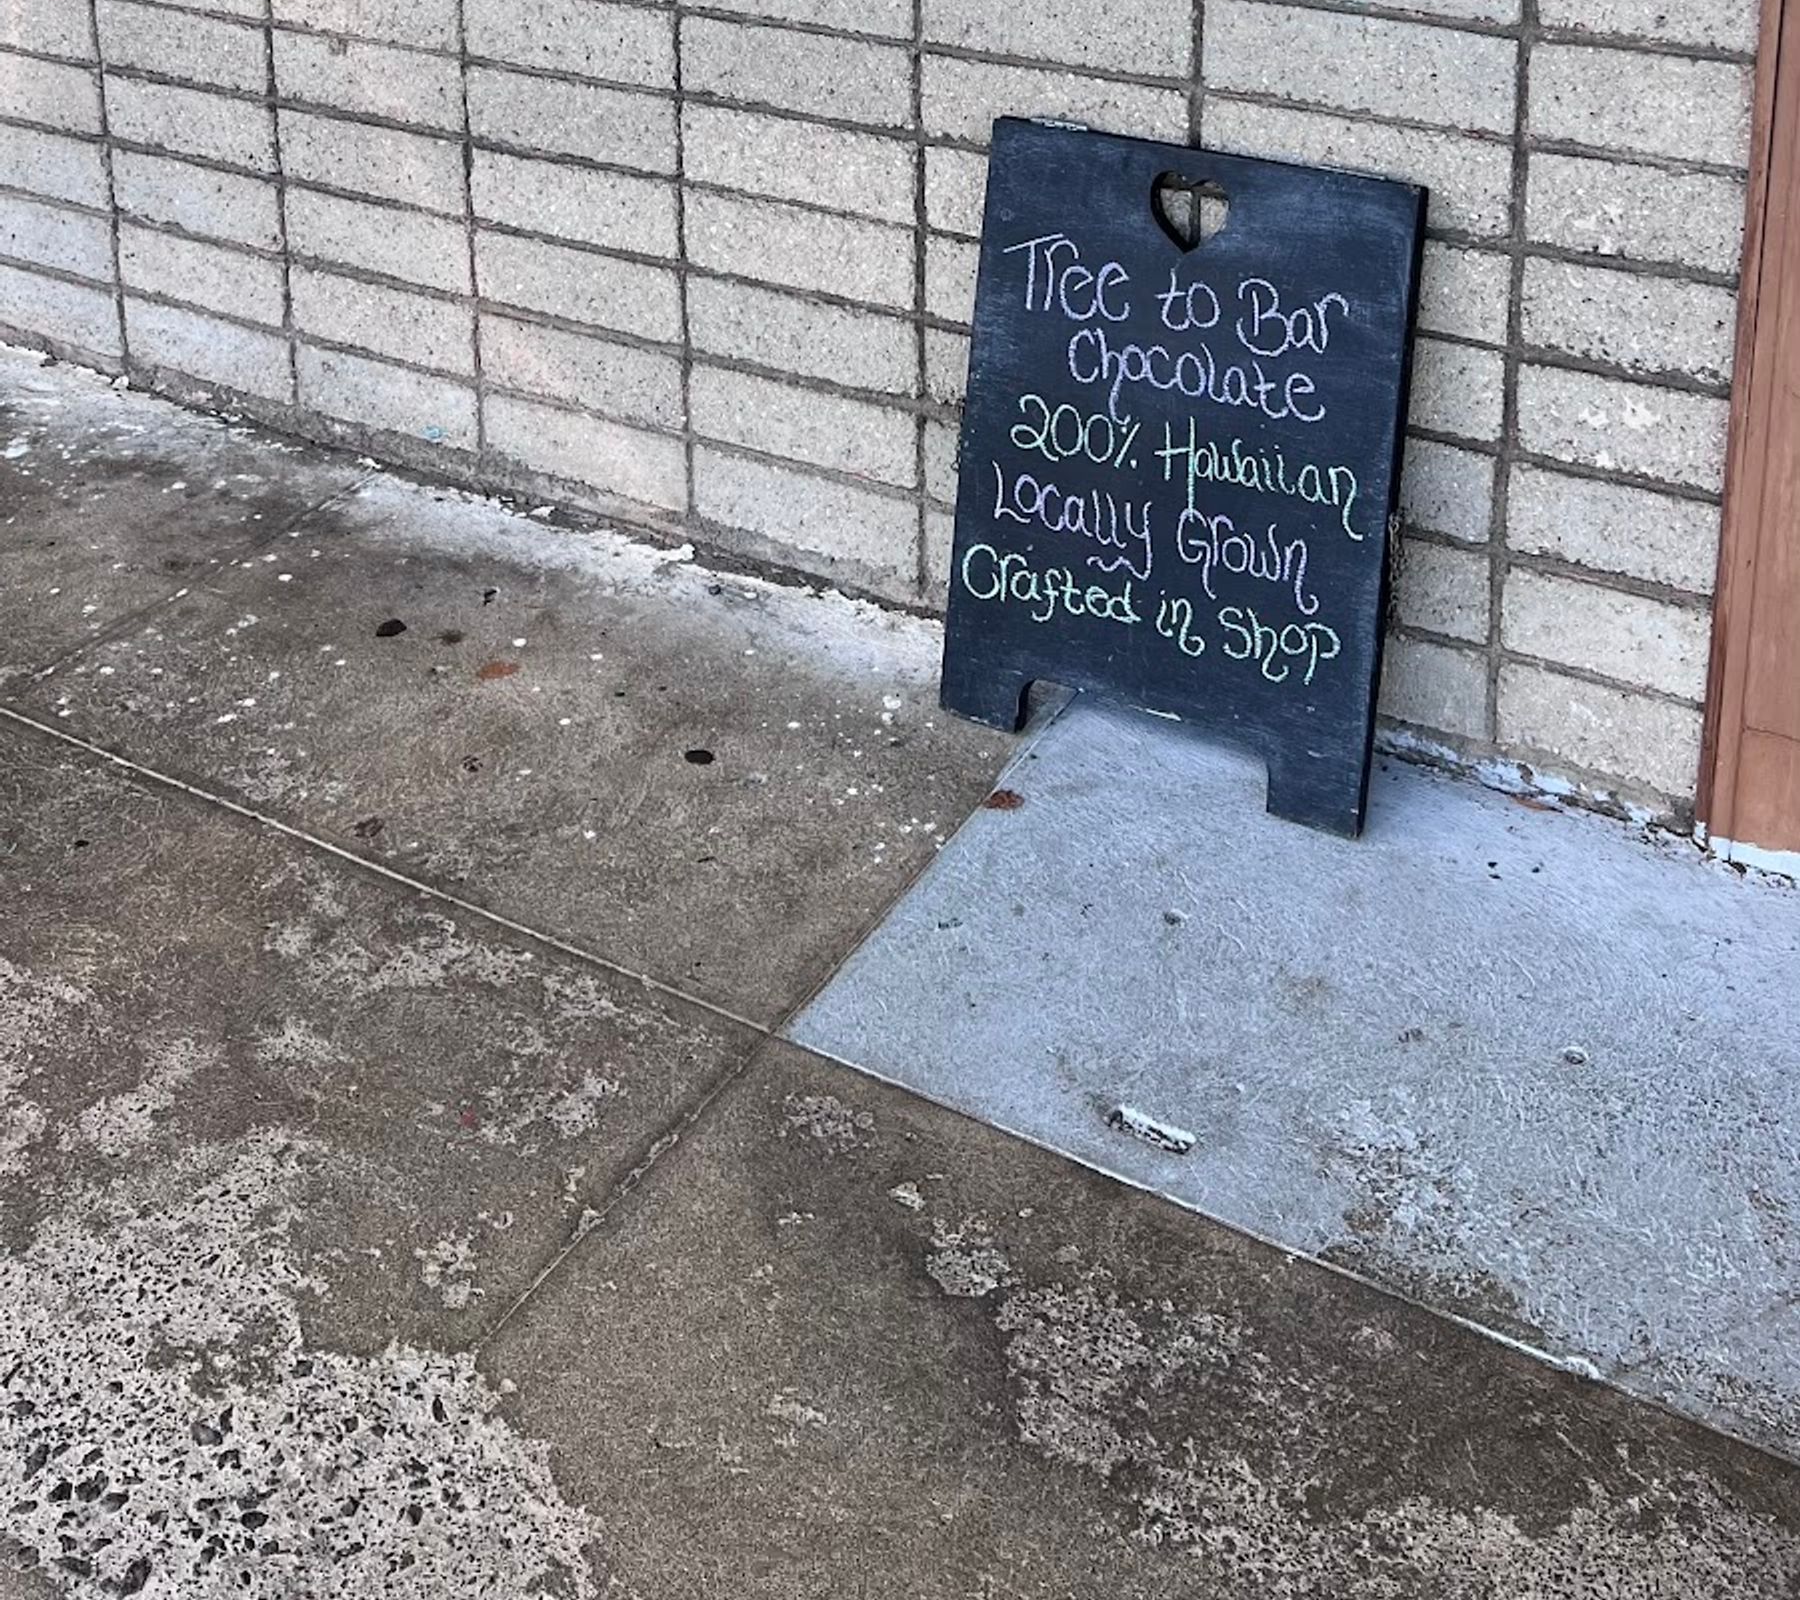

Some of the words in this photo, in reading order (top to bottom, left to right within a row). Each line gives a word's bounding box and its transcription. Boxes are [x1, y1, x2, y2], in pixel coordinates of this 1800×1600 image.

[1002, 232, 1132, 324] Tree
[1154, 265, 1223, 331] to
[1235, 277, 1350, 358] Bar
[1067, 327, 1327, 427] Chocolate
[992, 460, 1154, 582] Locally
[1175, 507, 1320, 616] Grown
[1009, 393, 1143, 470] 200%
[1153, 415, 1364, 542] Hawaiian
[961, 543, 1143, 624] Crafted
[1156, 589, 1206, 658] in
[1218, 605, 1342, 687] Shop
